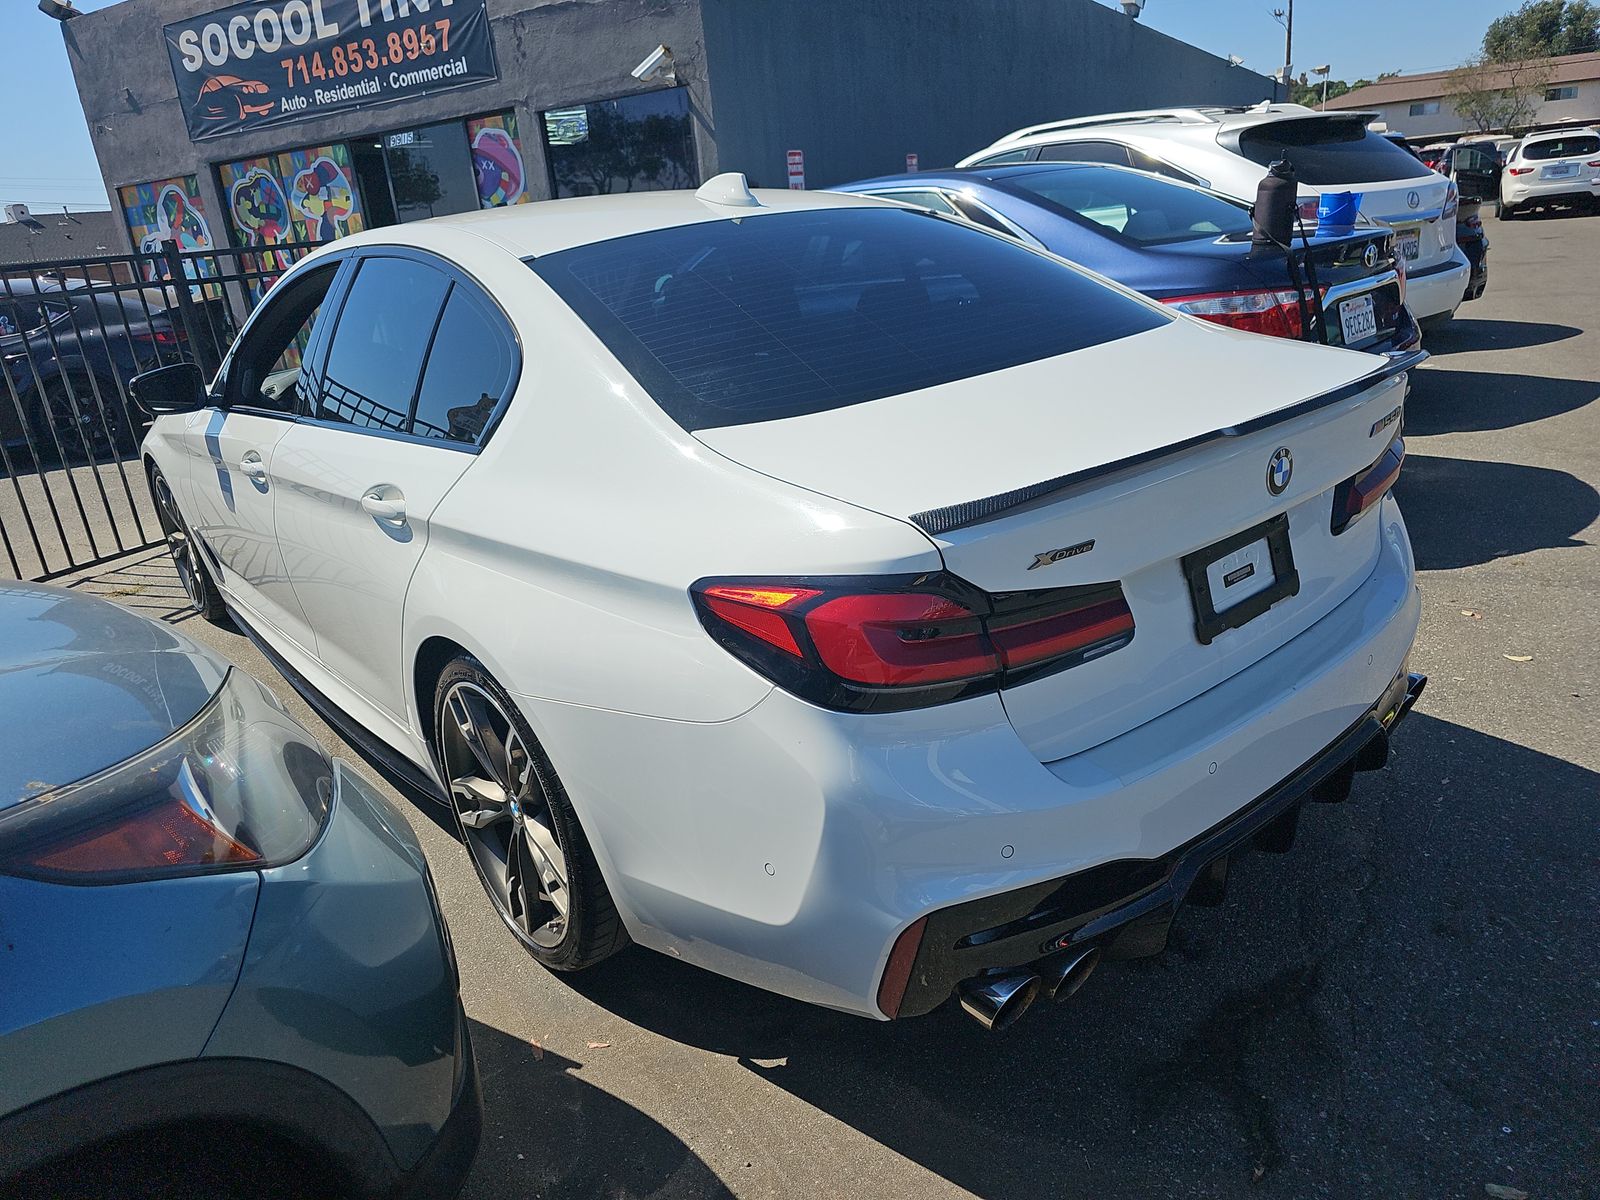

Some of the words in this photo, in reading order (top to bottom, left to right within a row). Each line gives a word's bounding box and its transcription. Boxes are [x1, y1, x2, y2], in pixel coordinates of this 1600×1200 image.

[179, 0, 339, 73] SOCOOL
[281, 18, 450, 88] 714.853.8967
[281, 96, 307, 112] Auto
[314, 76, 381, 106] Residential
[389, 55, 468, 90] Commercial
[390, 132, 413, 147] 9915
[1344, 310, 1375, 338] 9ECE282
